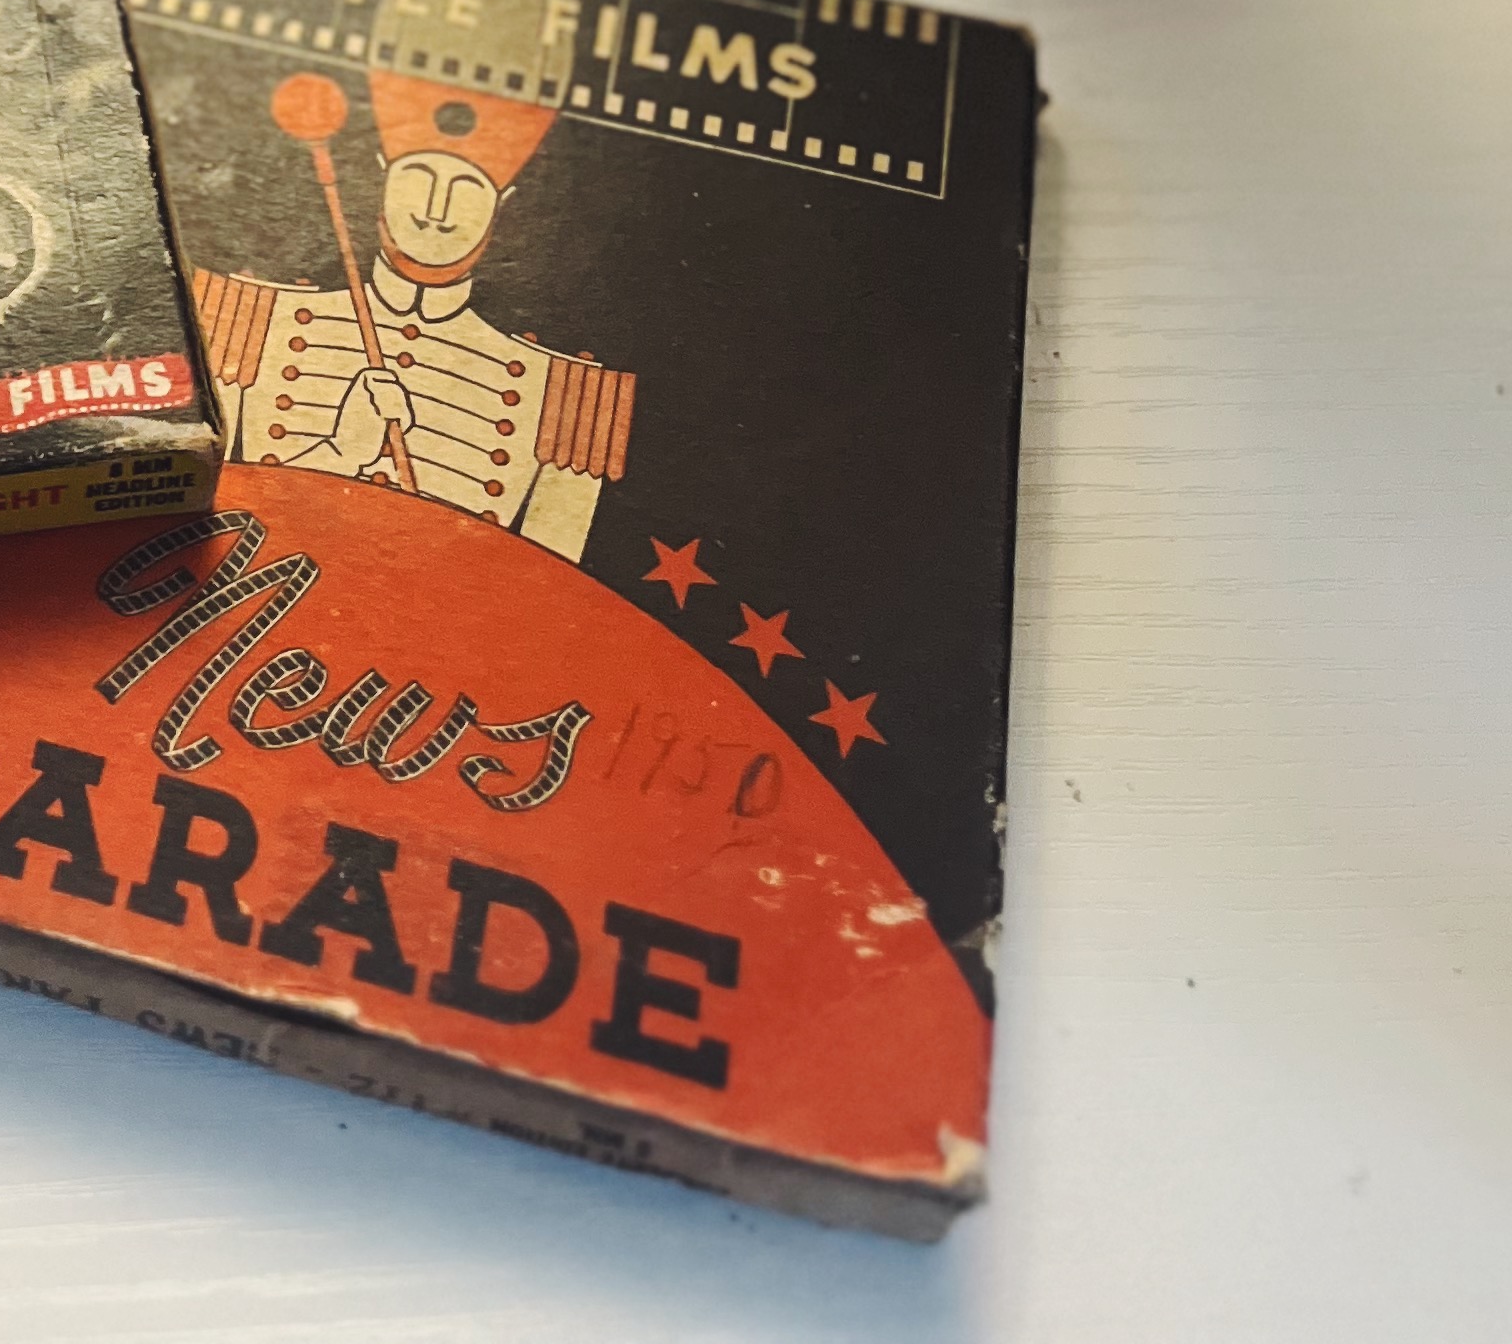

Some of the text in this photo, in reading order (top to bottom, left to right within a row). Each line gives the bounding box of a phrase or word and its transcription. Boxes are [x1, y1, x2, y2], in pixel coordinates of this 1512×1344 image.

[9, 362, 174, 424] FILMS
[94, 491, 186, 513] EDITION
[95, 509, 591, 811] News
